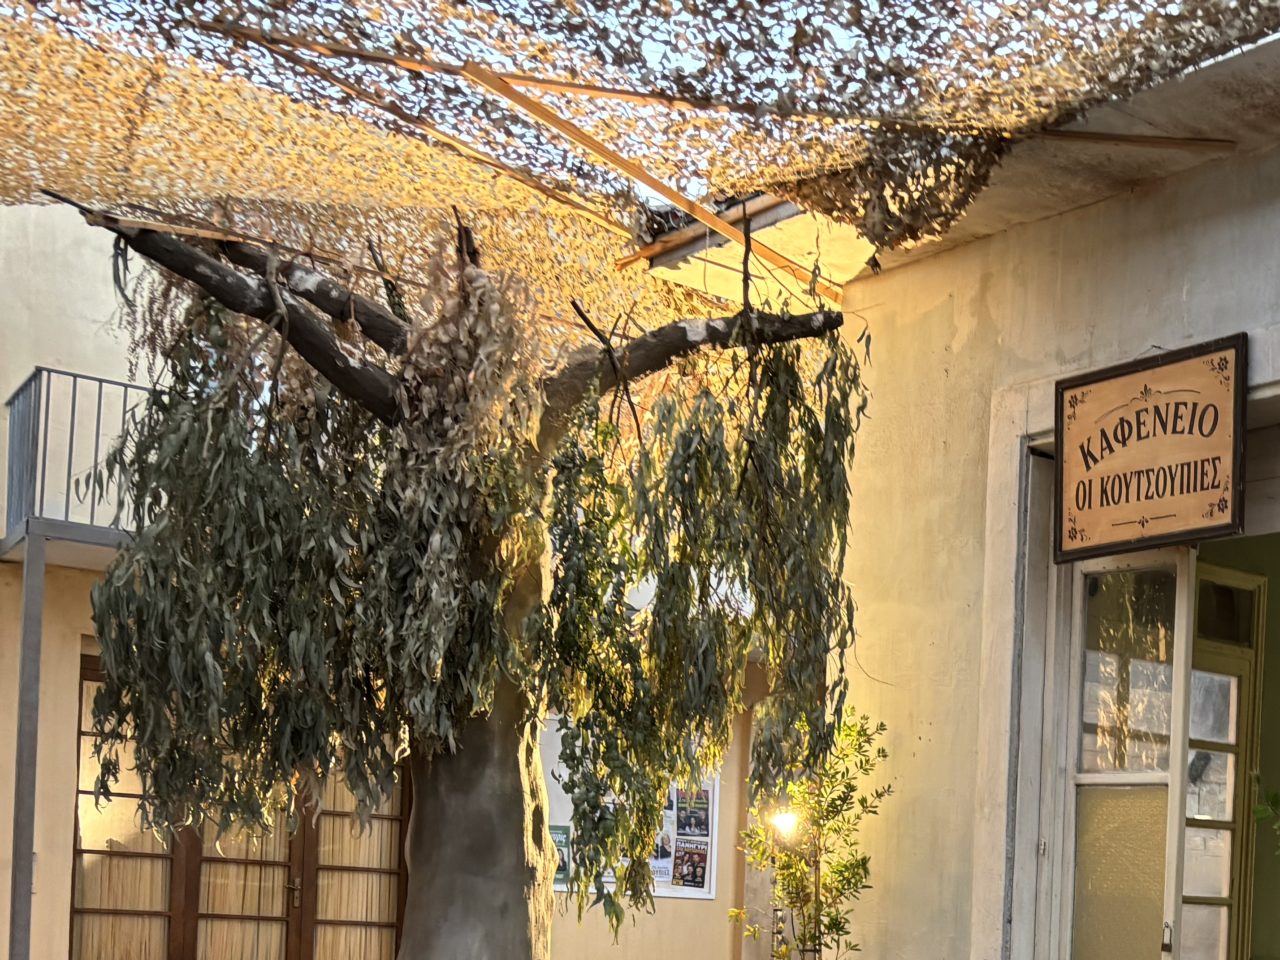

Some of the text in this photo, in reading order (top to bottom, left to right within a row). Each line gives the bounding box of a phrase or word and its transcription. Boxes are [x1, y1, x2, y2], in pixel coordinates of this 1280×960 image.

[1078, 401, 1219, 472] ΚΑΦΕΝΕΙΟ
[1075, 456, 1222, 511] ΟΙ ΚΟΥΤΣΟΥΠΙΕΣ
